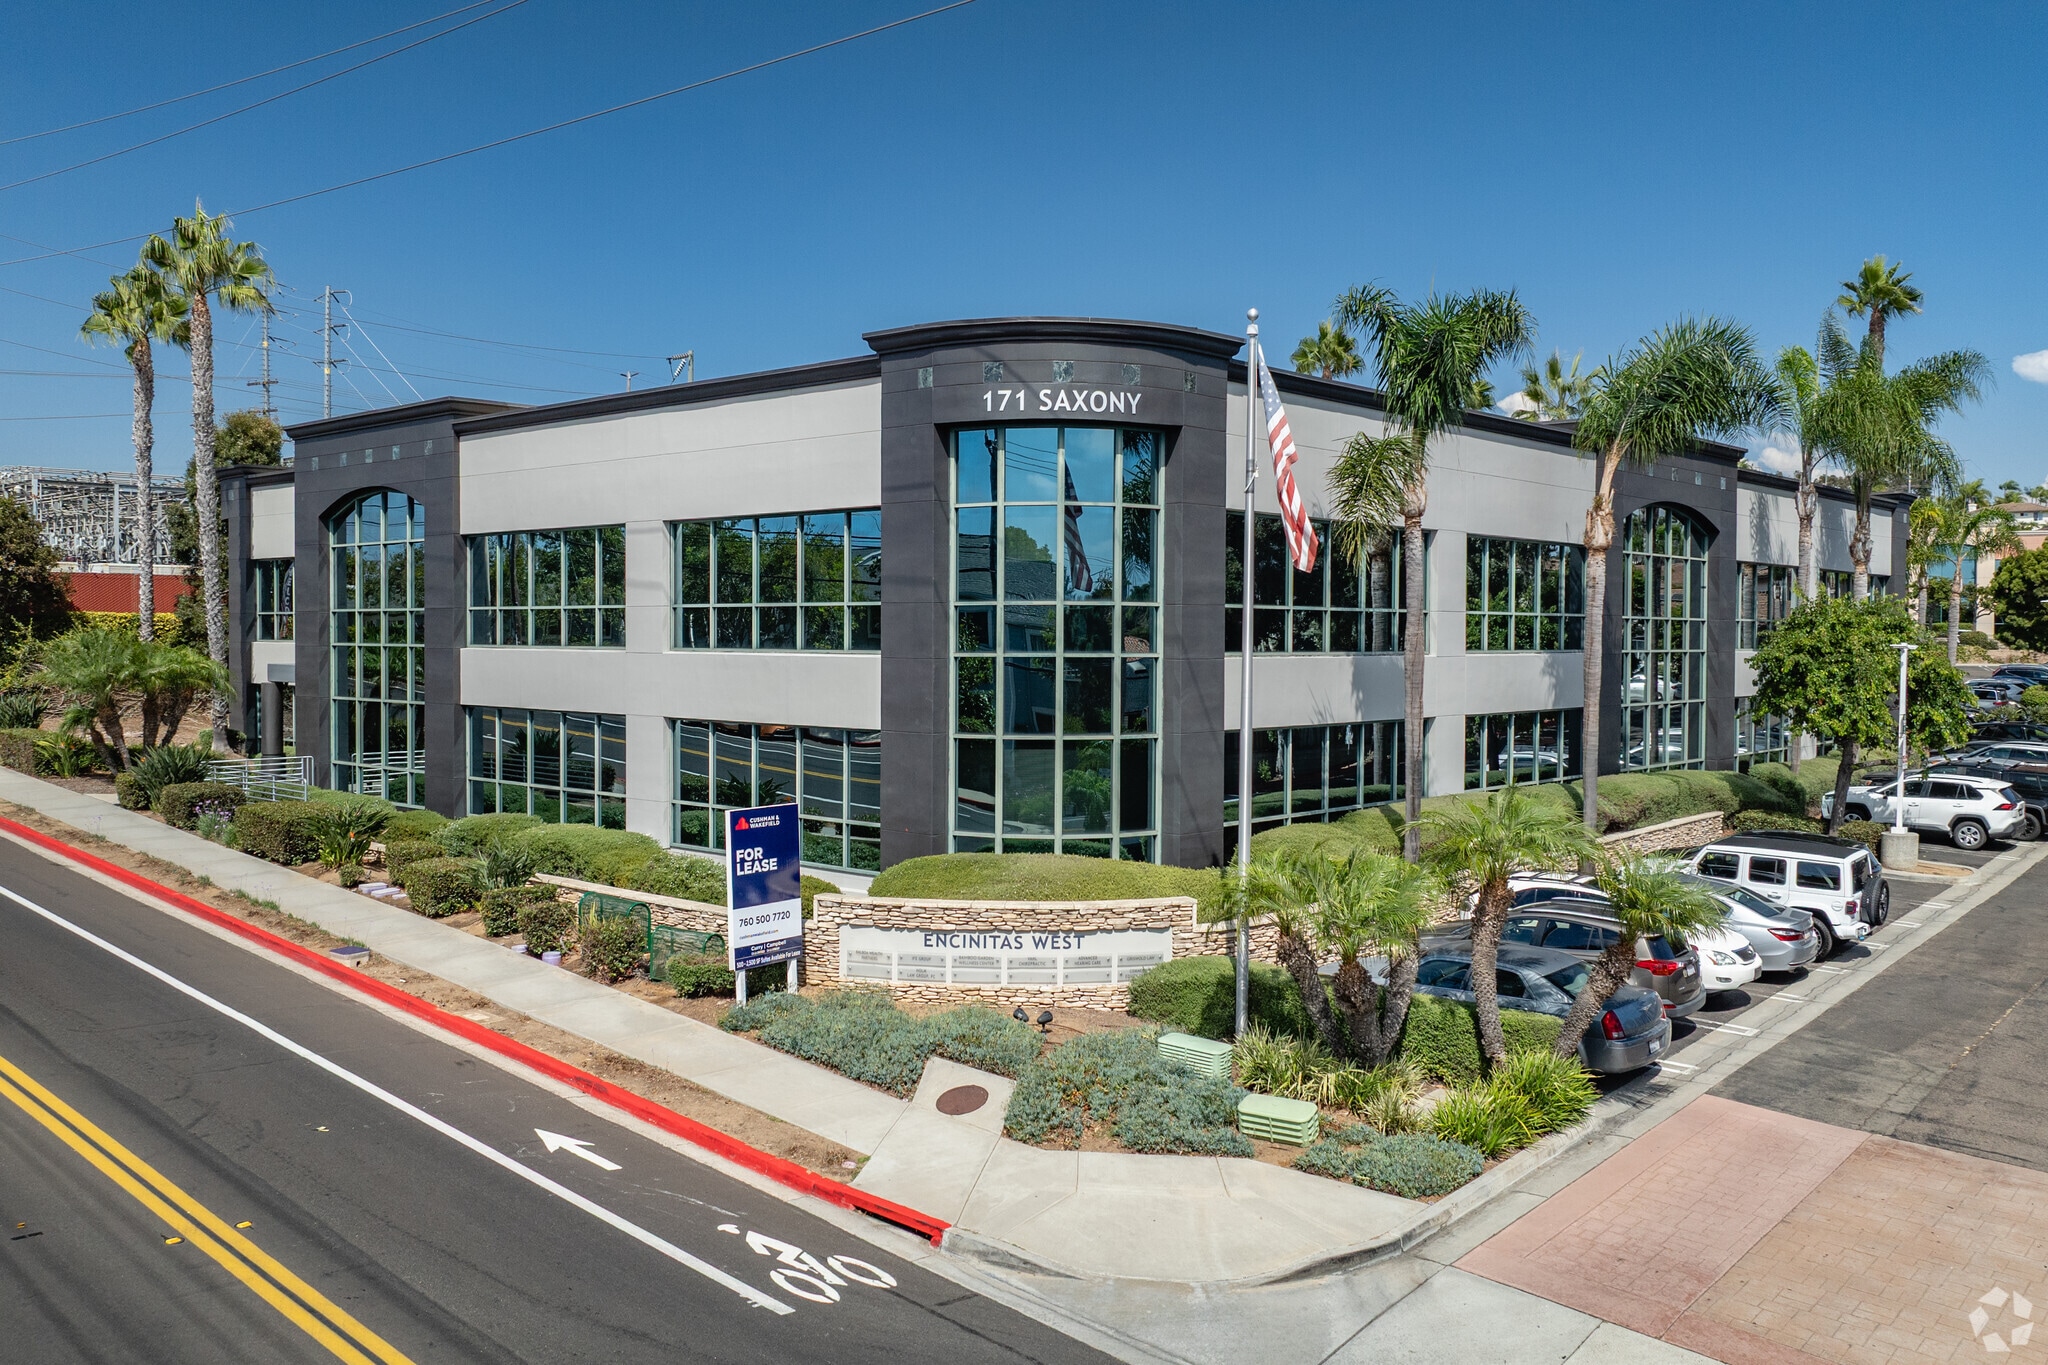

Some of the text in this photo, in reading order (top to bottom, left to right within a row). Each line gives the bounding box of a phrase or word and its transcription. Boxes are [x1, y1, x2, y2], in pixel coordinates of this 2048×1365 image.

[983, 389, 1142, 415] 171 SAXONY
[749, 816, 775, 824] CUSHMAN
[749, 820, 781, 829] WAKEFIELD
[736, 847, 763, 863] FOR
[736, 858, 778, 876] LEASE
[738, 910, 791, 928] 760 500 7720
[766, 940, 787, 948] Campbell
[924, 933, 1085, 950] ENCINITAS WEST
